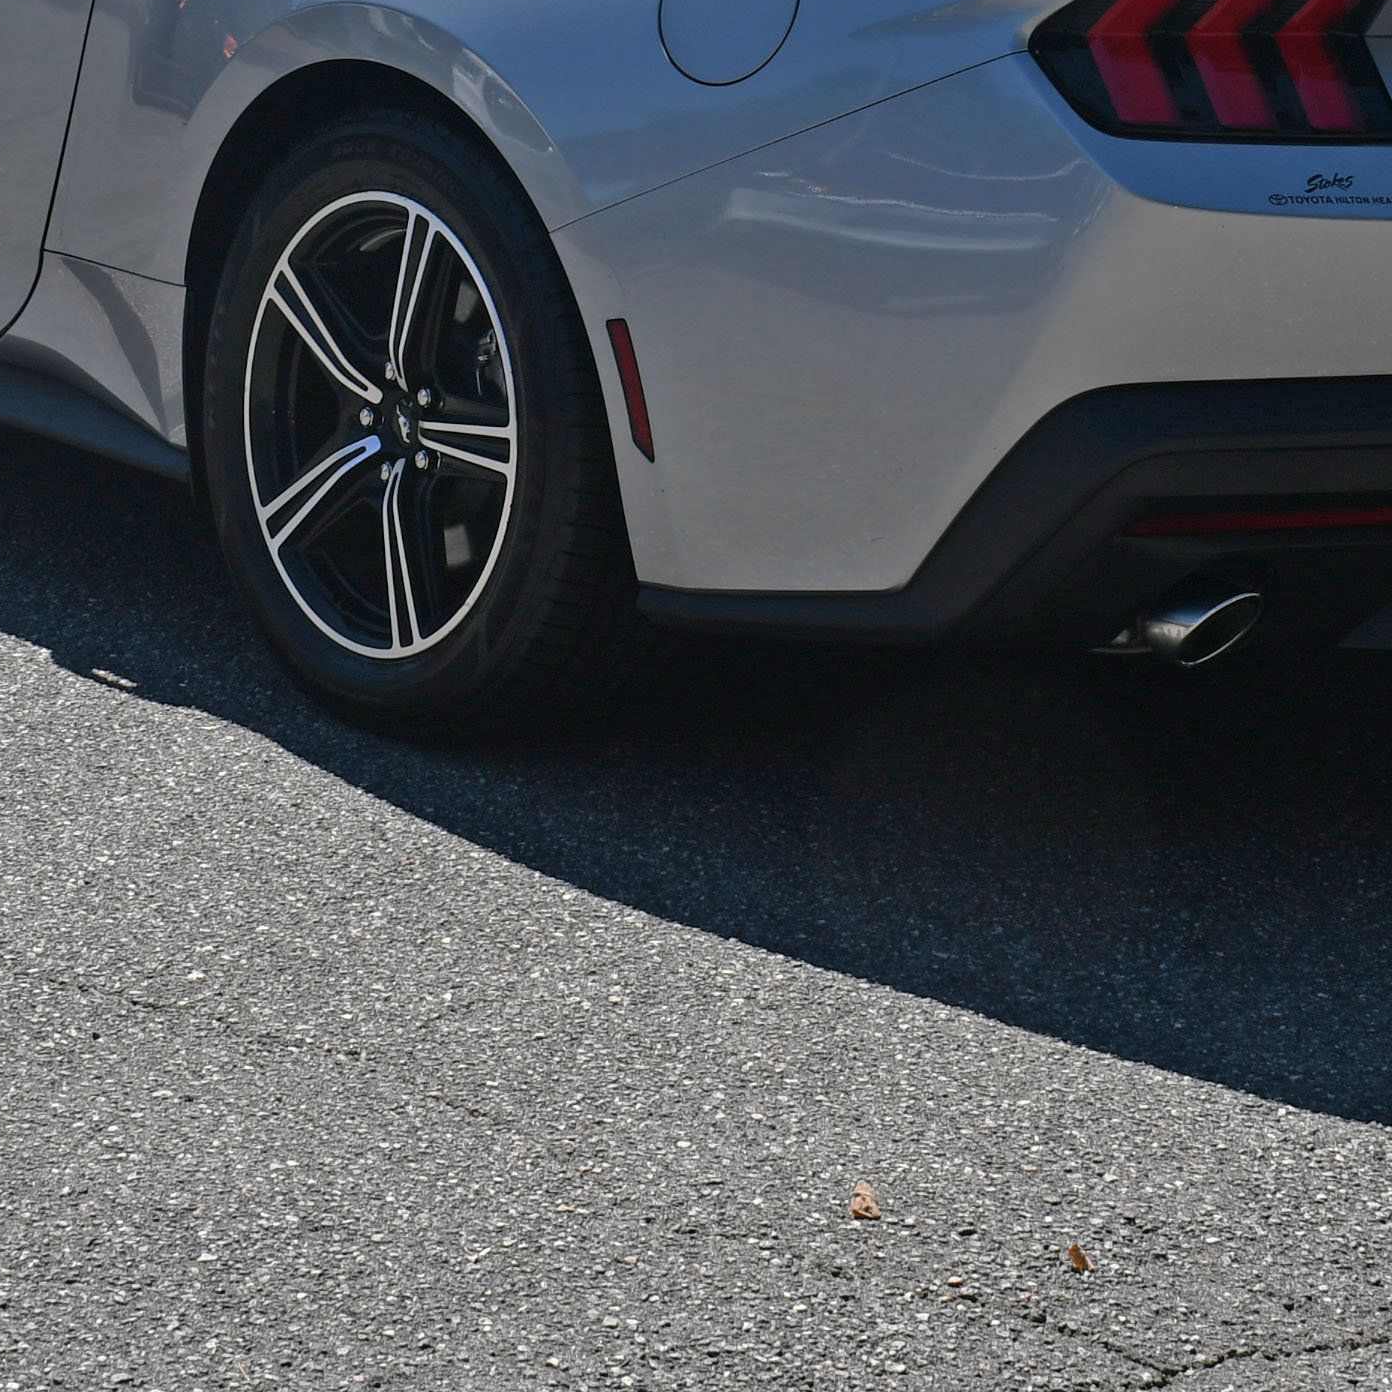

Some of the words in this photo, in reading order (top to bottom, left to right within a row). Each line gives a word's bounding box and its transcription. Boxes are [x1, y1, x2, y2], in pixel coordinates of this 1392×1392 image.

[1304, 172, 1354, 193] Stokes
[1288, 196, 1333, 204] TOYOTA
[1335, 196, 1370, 205] HILTON
